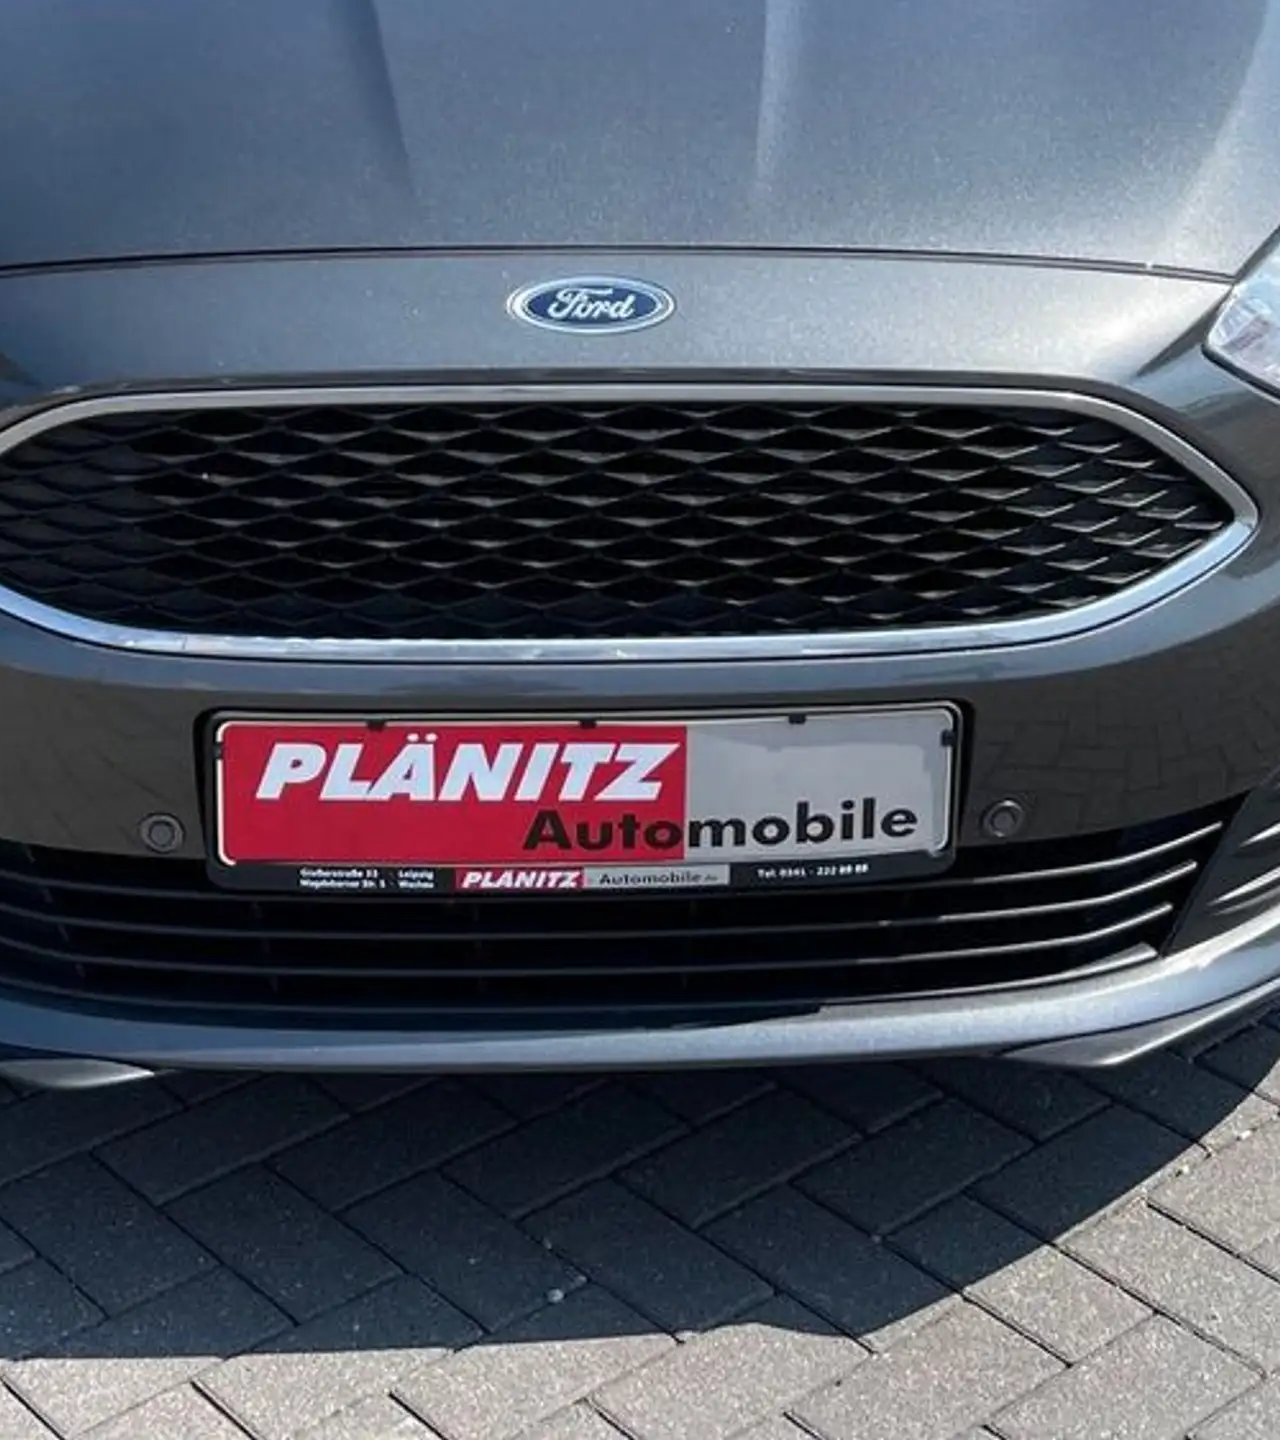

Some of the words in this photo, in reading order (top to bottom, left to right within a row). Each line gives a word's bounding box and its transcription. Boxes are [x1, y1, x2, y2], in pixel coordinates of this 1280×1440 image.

[547, 287, 637, 319] Ford
[256, 732, 680, 802] PLÄNITZ
[522, 796, 918, 852] Automobile
